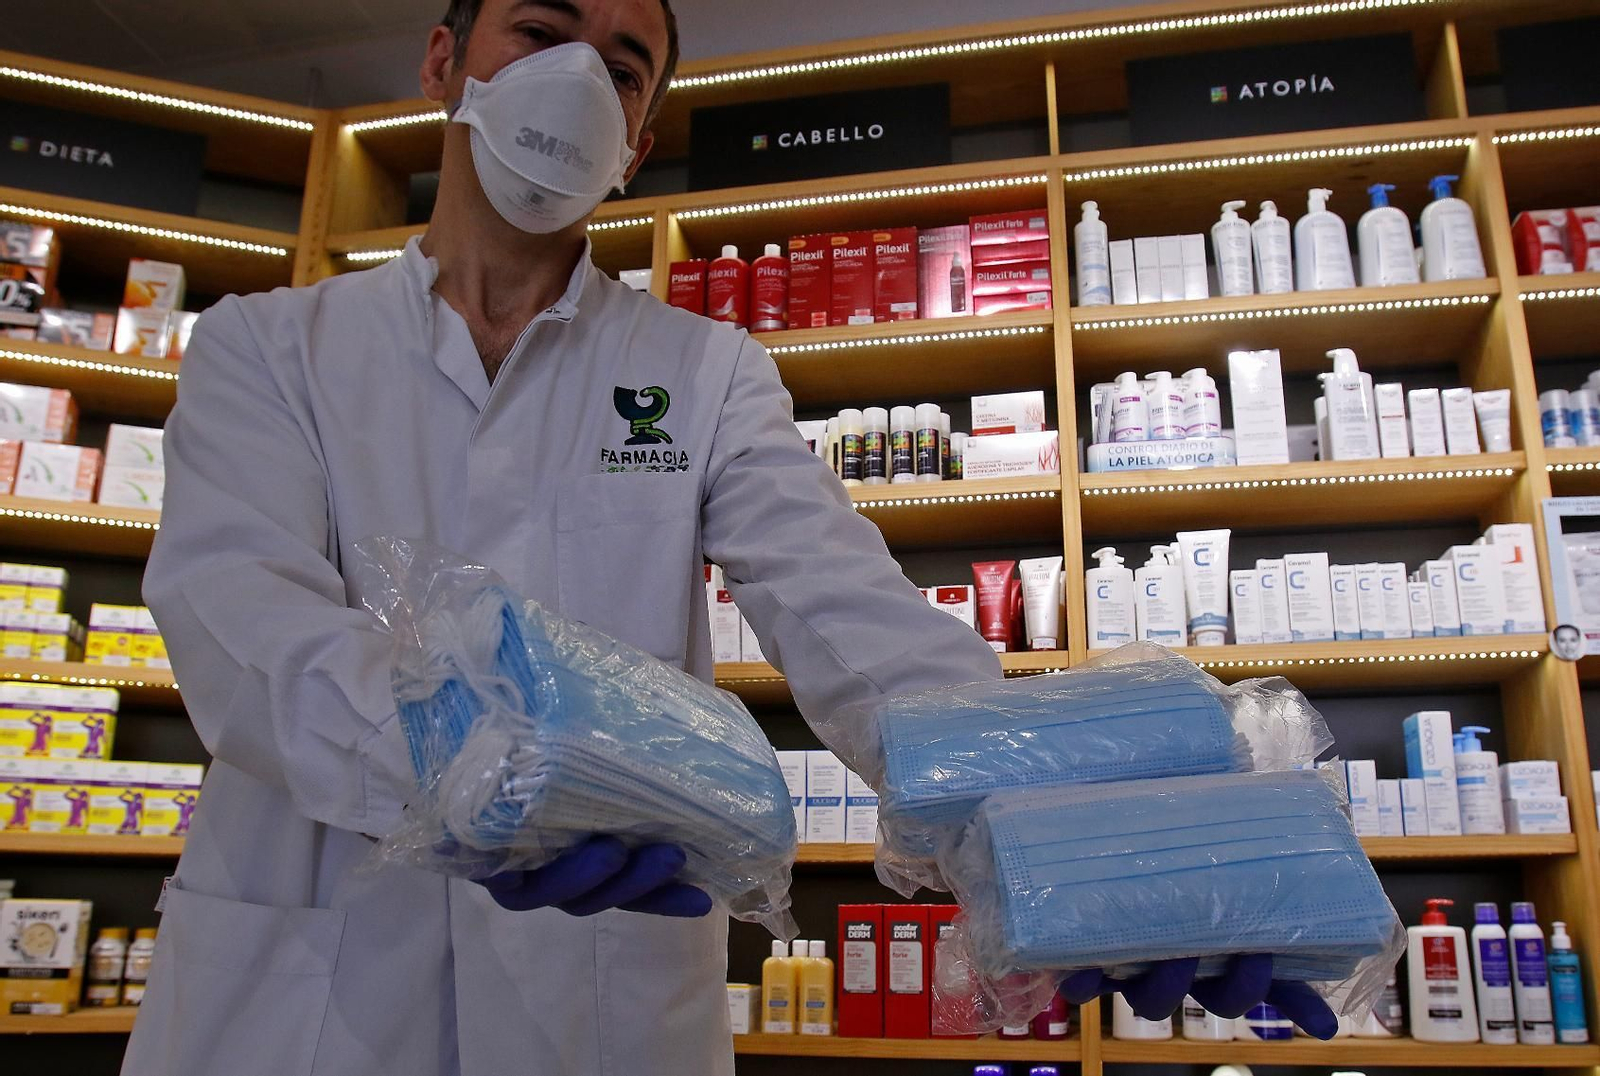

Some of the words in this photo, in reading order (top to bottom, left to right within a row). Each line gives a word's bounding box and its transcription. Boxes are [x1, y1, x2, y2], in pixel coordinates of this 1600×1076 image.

[1239, 74, 1335, 100] ATOPÍA
[515, 126, 558, 158] 3M
[778, 124, 884, 148] CABELLO
[39, 140, 114, 168] DIETA
[832, 247, 867, 260] Pilexil
[875, 243, 909, 256] Pilexil
[790, 250, 824, 264] Pilexil
[671, 272, 701, 283] Pilexil
[1108, 444, 1160, 455] CONTROL
[1163, 442, 1197, 453] DIARIO
[1201, 441, 1214, 450] DE
[600, 448, 689, 465] FARMACIA
[1109, 457, 1124, 467] LA
[1128, 456, 1154, 466] PIEL
[1156, 453, 1214, 465] ATÓPICA
[848, 930, 871, 938] DERM
[894, 930, 917, 938] DERM
